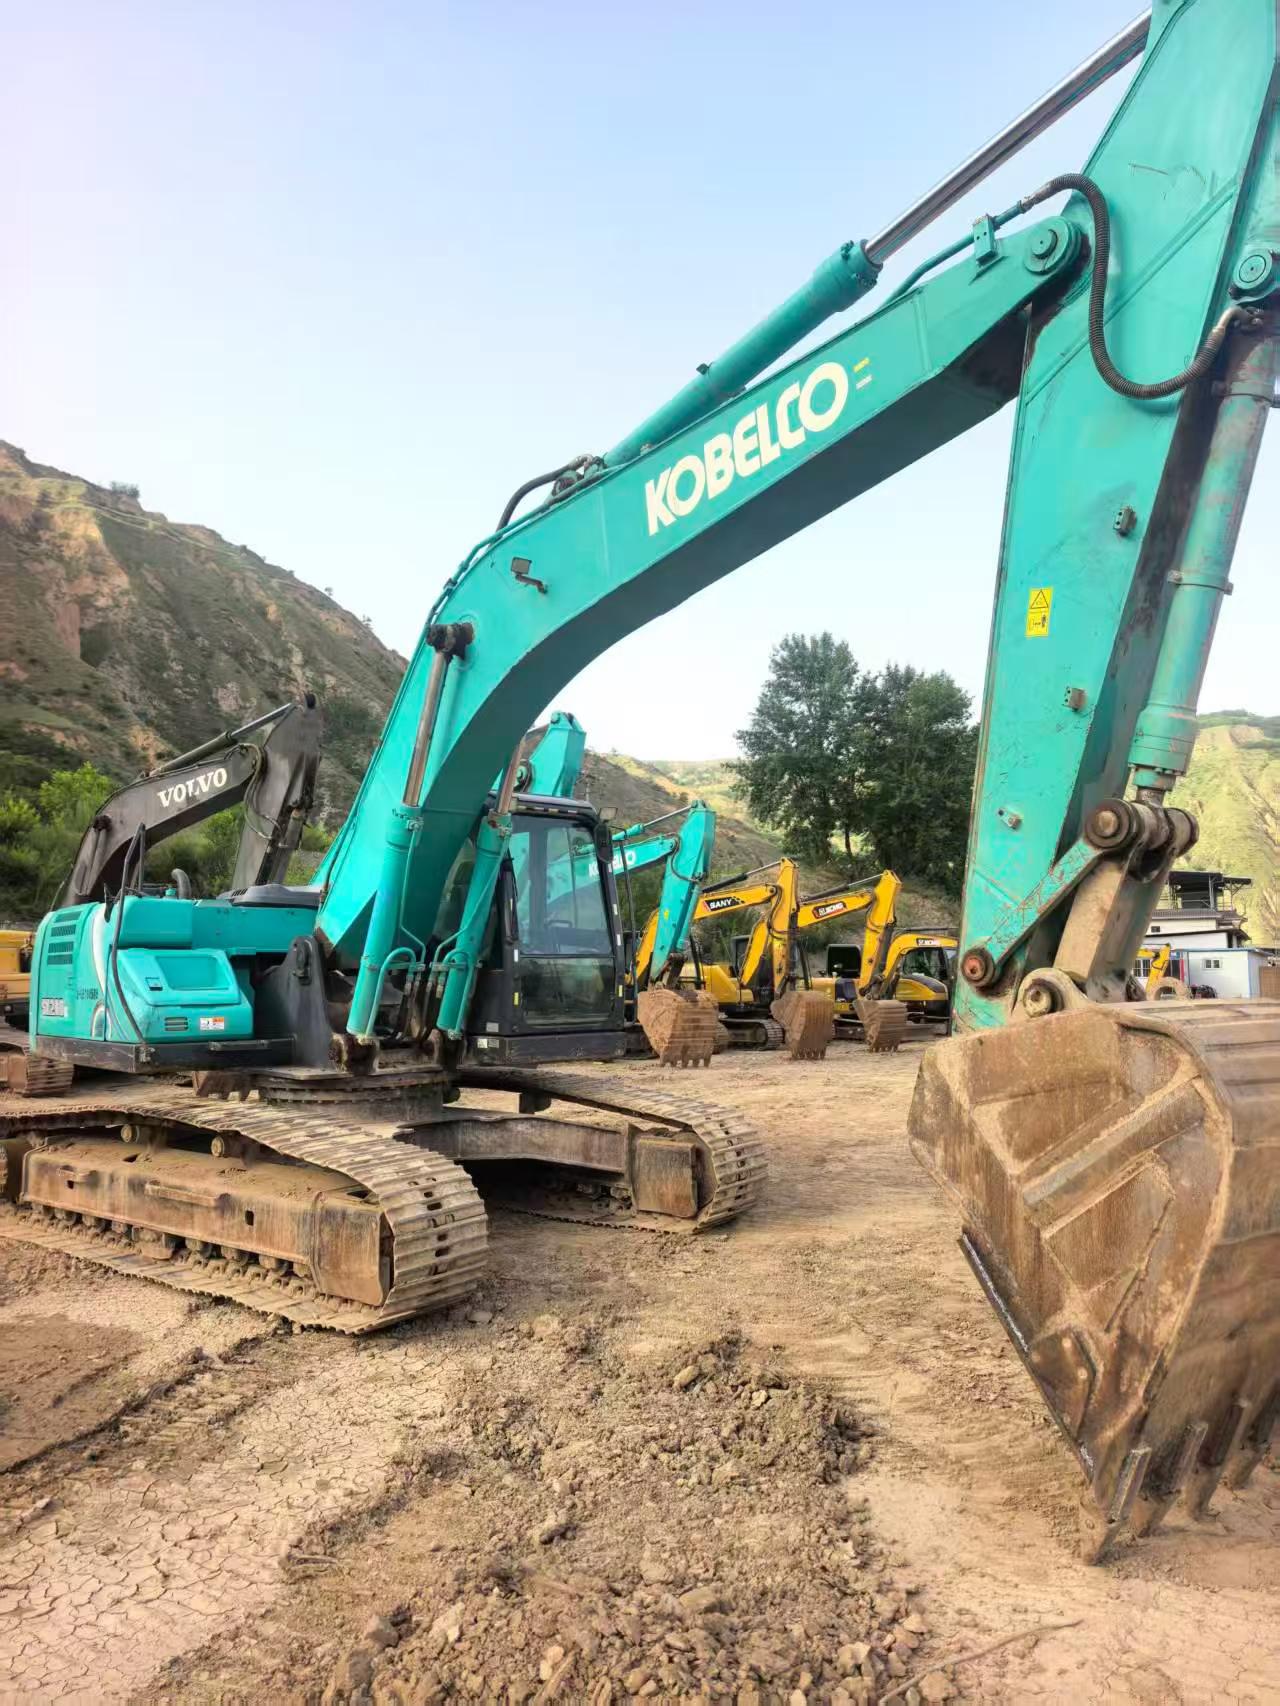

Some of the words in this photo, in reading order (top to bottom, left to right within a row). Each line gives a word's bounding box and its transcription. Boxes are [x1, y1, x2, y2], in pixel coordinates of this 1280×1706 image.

[644, 362, 849, 536] KOBELCO
[157, 768, 227, 808] VOLVO
[709, 898, 732, 910] SANY
